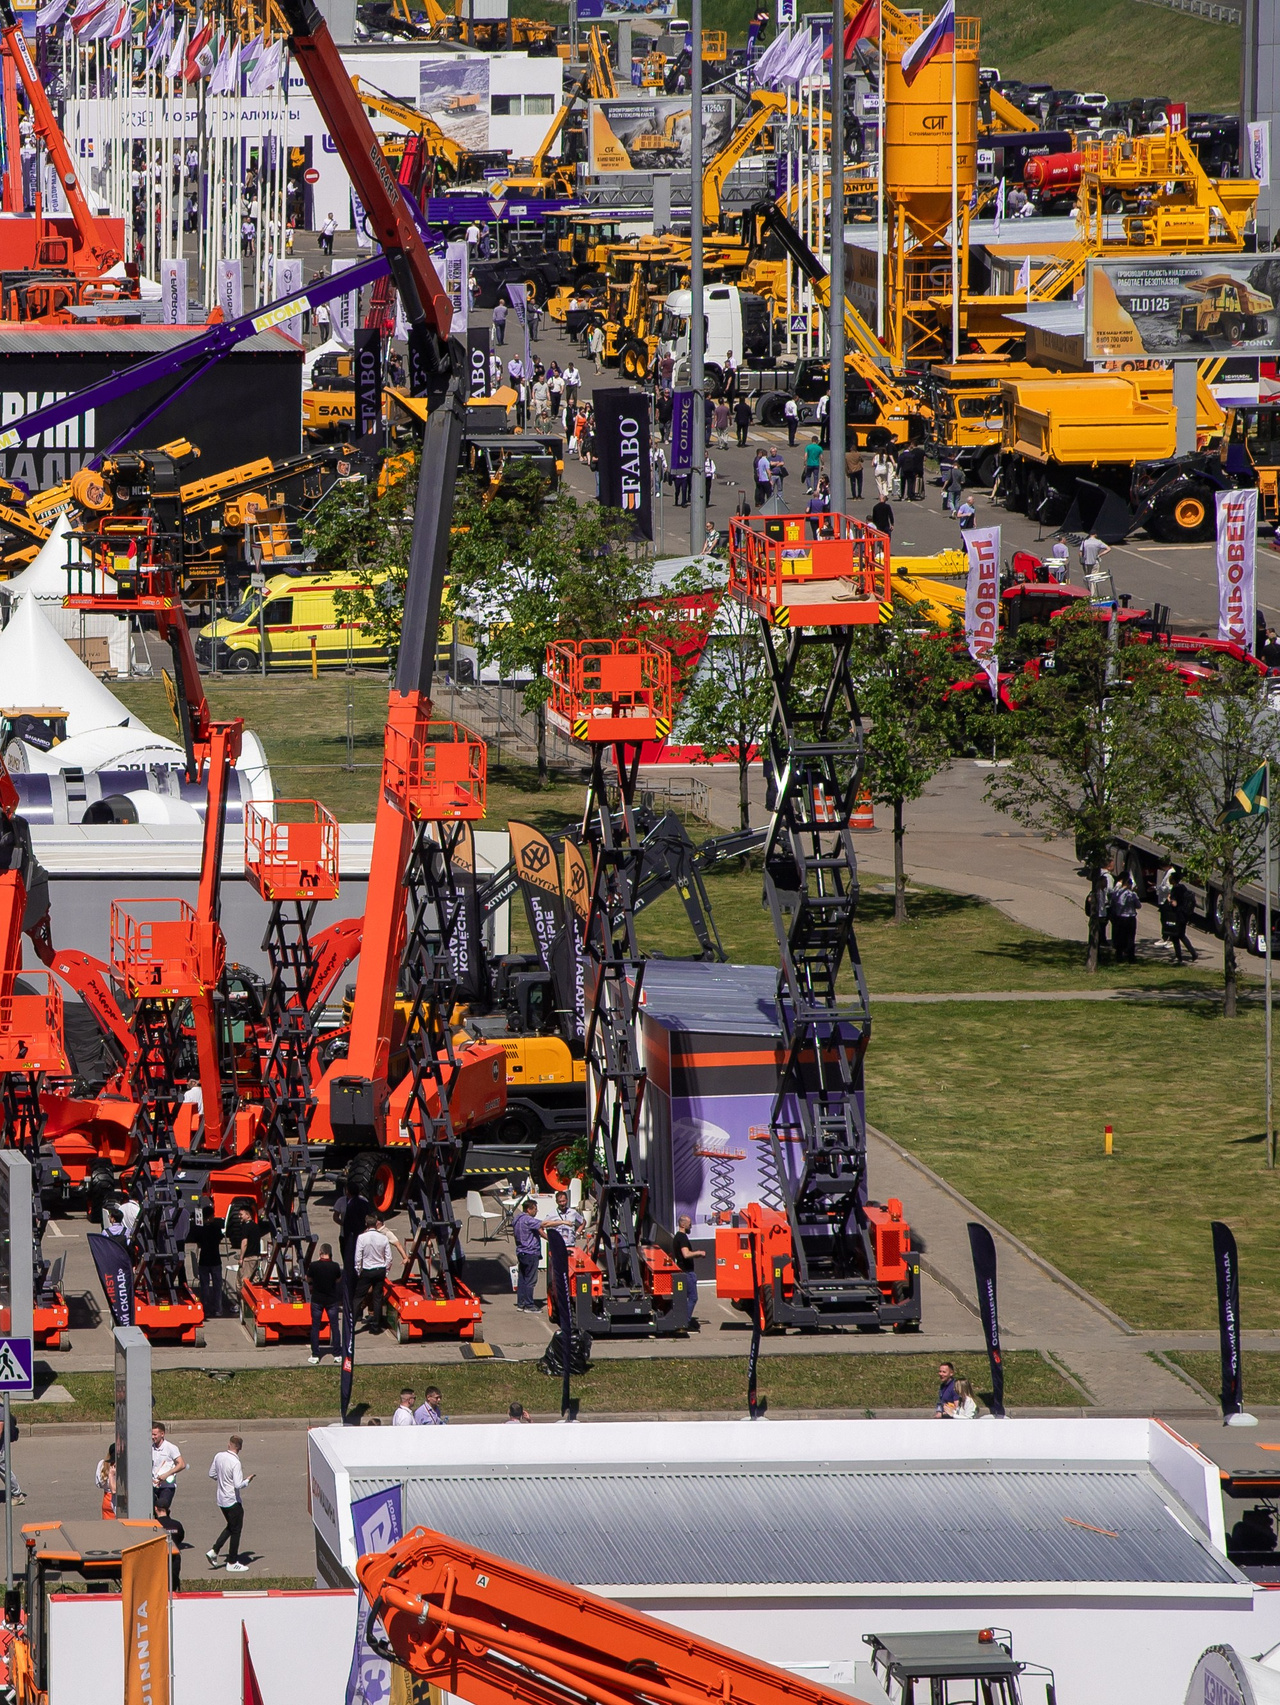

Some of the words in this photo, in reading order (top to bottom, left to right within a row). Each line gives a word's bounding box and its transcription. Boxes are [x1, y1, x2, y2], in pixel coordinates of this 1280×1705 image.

[842, 183, 874, 193] ANTUI
[360, 351, 375, 418] FABO
[471, 350, 485, 398] ABO
[318, 405, 357, 417] SAN
[679, 398, 692, 450] ЭКСПО
[620, 417, 640, 493] FABO
[311, 952, 338, 996] ProKeeper
[88, 979, 119, 1022] ProKeeper
[987, 1278, 999, 1346] ОСВЕЩЕНИЕ
[477, 1576, 486, 1586] A
